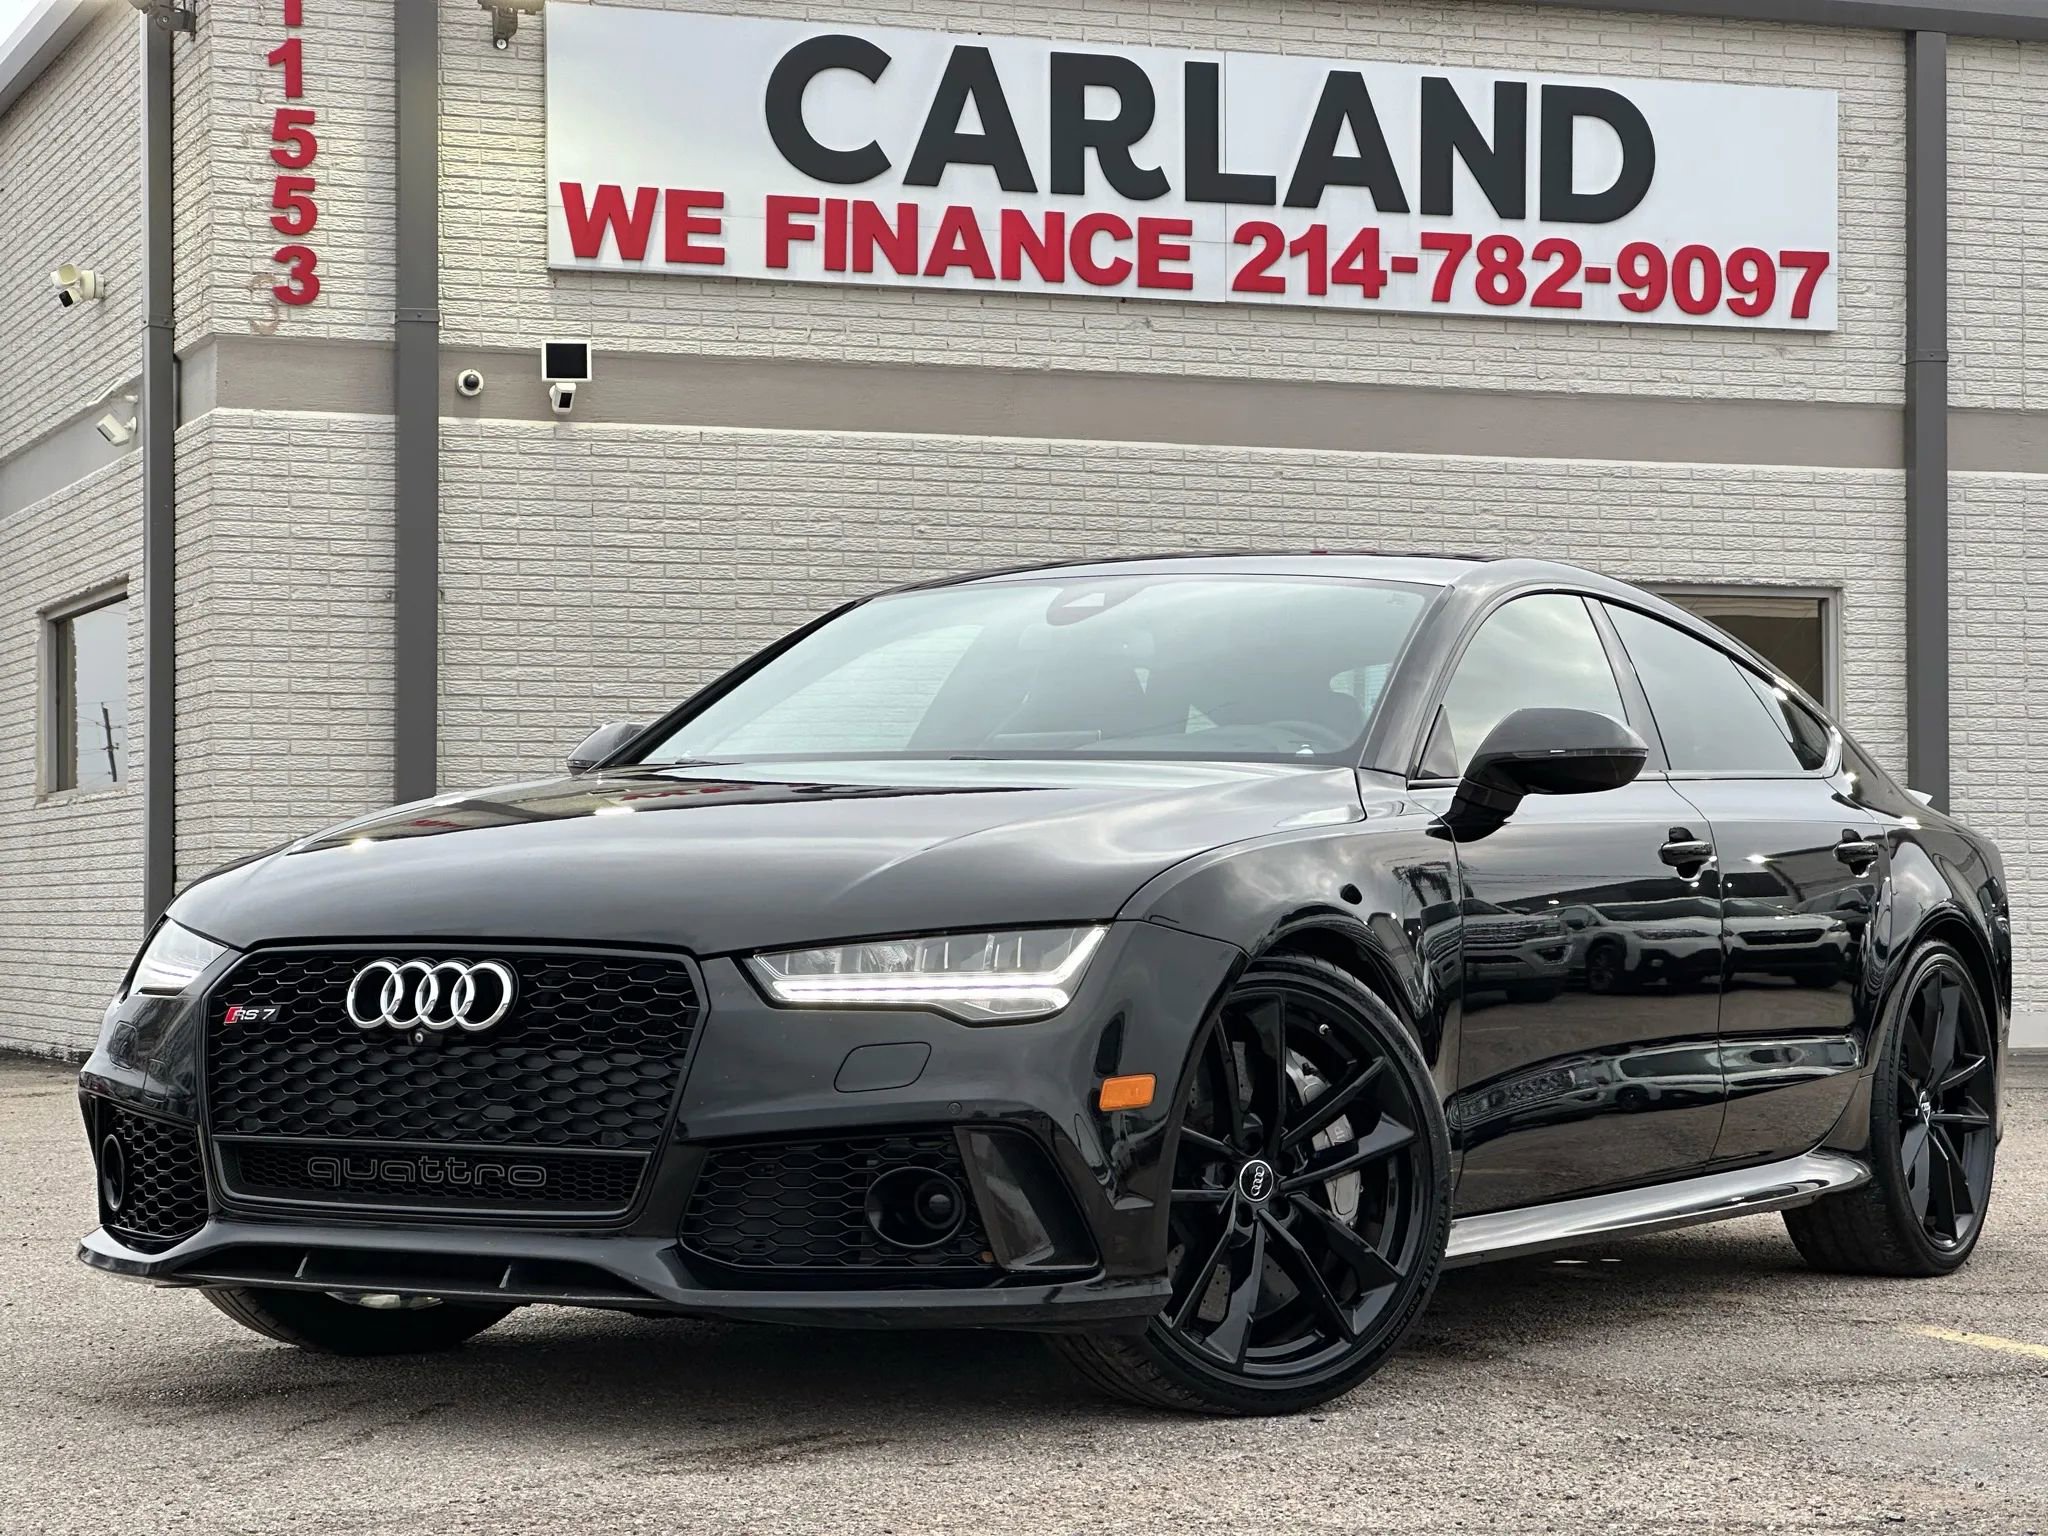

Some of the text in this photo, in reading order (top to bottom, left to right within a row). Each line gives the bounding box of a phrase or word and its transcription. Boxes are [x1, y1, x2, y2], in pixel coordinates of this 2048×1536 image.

[766, 35, 1656, 225] CARLAND
[560, 183, 1830, 319] WE FINANCE 214-782-9097
[229, 1006, 277, 1022] RS 7
[307, 1156, 547, 1188] quattro
